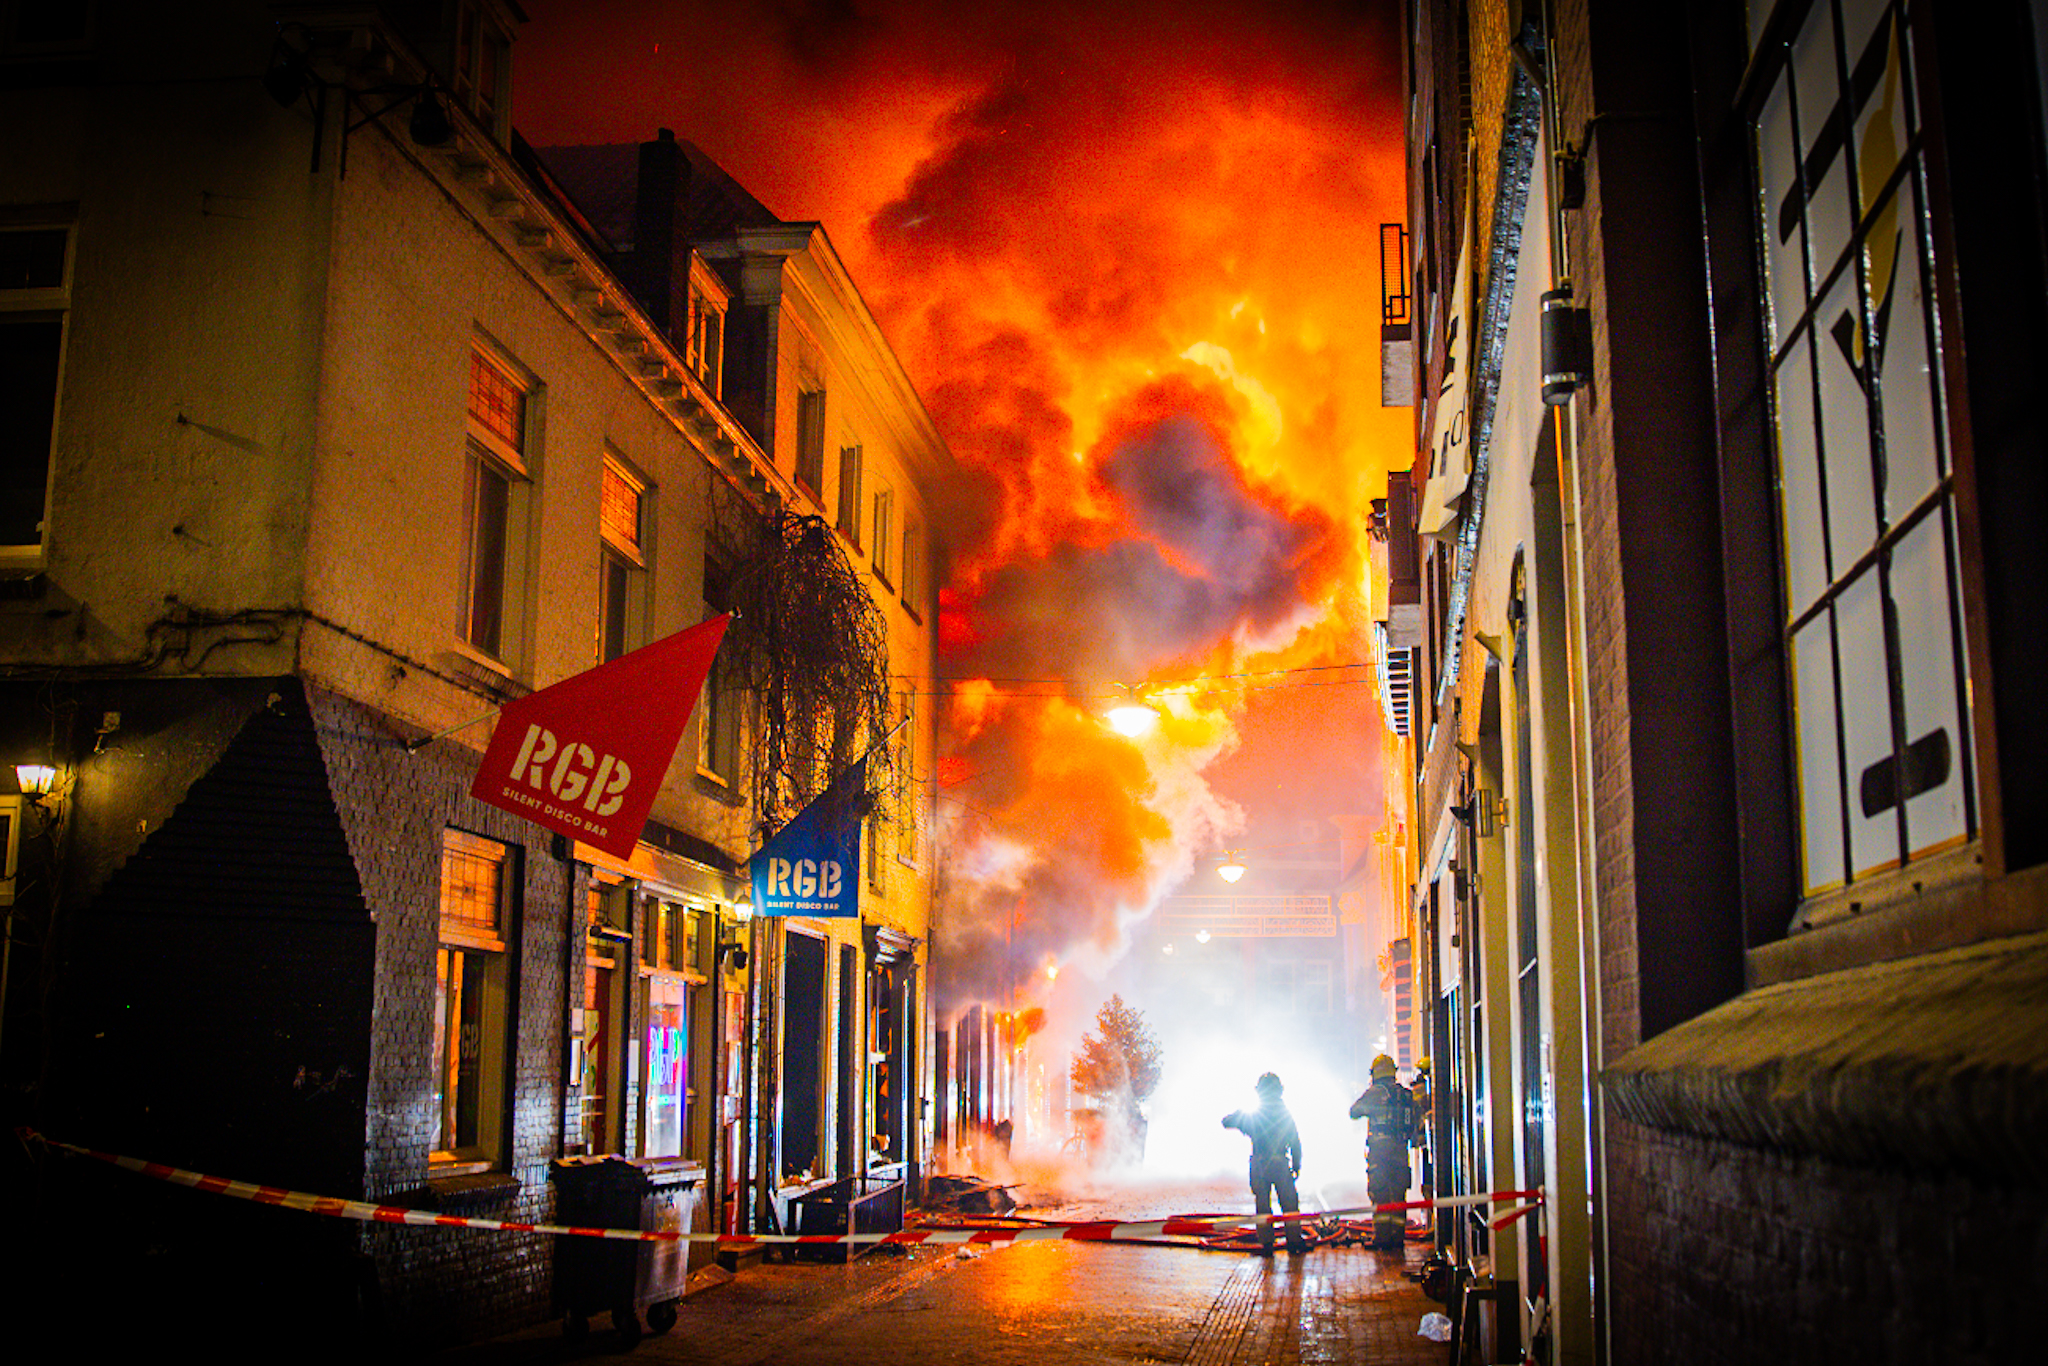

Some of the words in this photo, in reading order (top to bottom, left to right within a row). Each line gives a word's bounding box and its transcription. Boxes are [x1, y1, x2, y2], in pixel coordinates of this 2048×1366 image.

[508, 722, 632, 817] RGB
[502, 786, 543, 810] SILENT
[543, 803, 582, 827] DISCO
[584, 820, 608, 838] BAR
[766, 857, 842, 899] RGB
[766, 901, 794, 909] SILENT
[795, 901, 822, 910] DISCO
